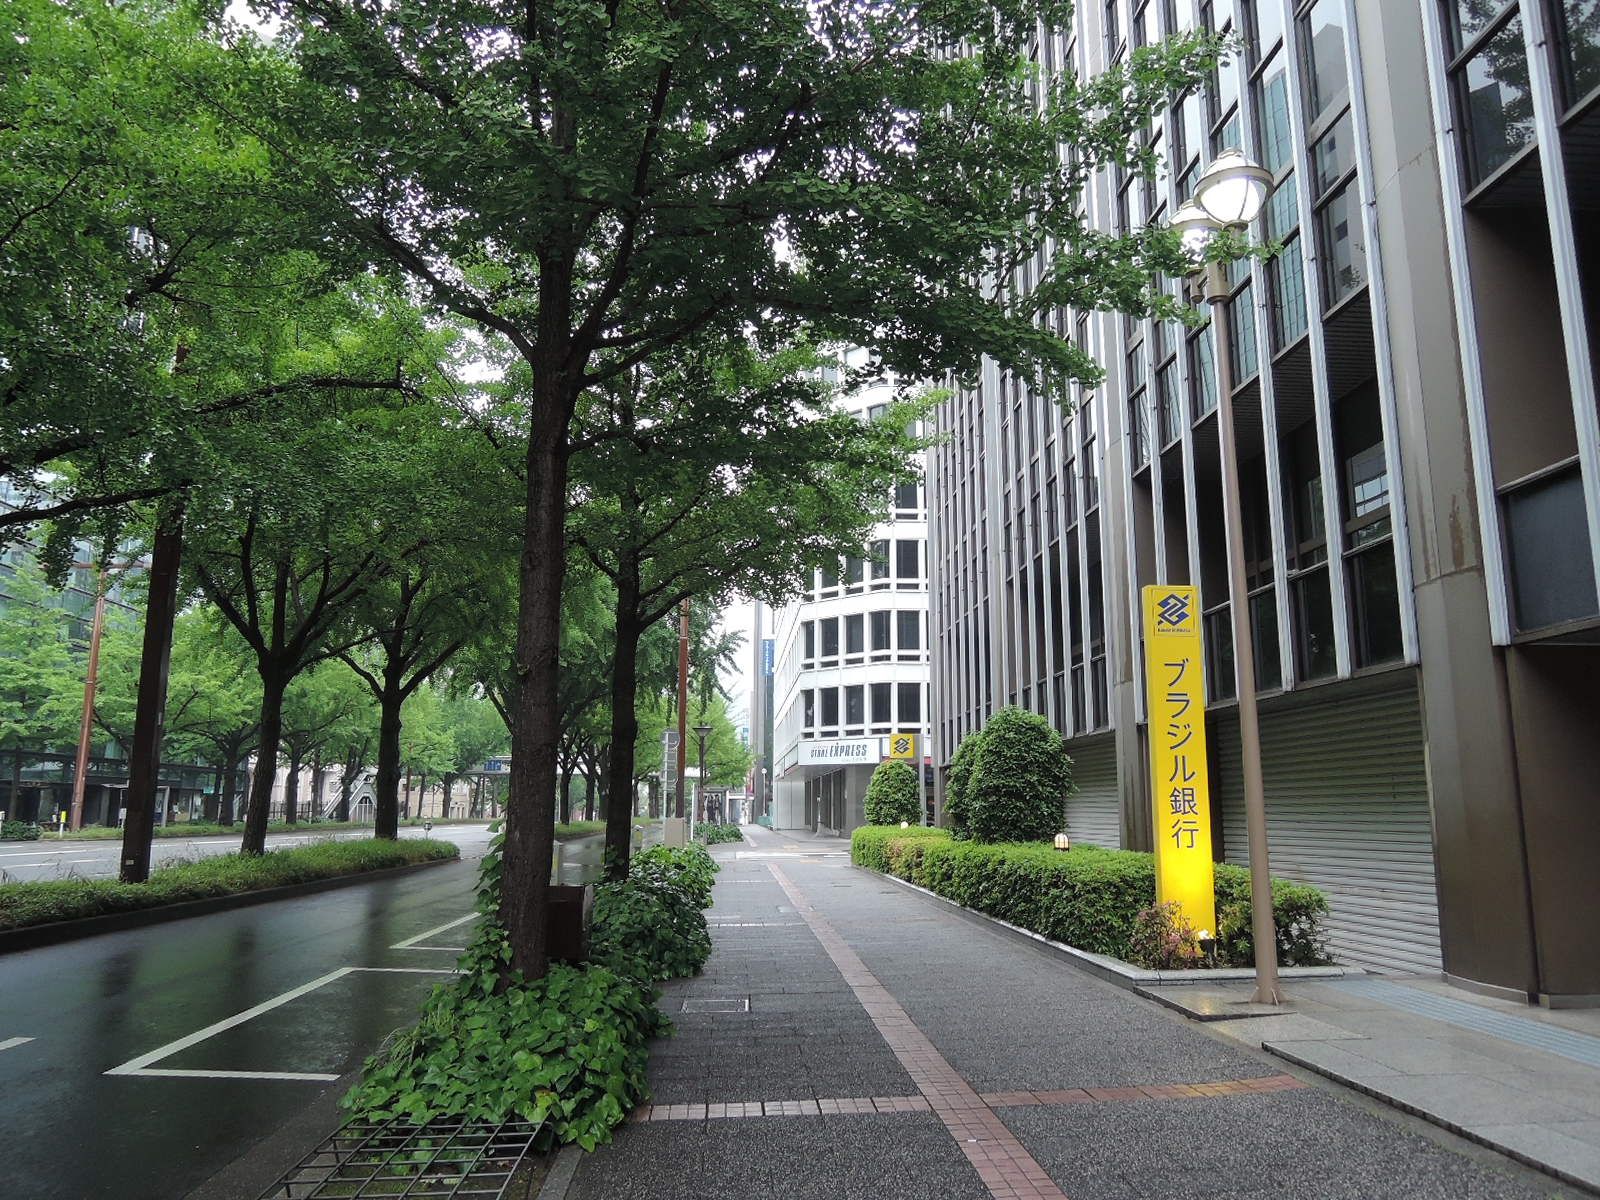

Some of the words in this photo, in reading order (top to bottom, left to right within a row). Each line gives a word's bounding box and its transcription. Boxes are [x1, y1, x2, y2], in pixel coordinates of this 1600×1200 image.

[829, 743, 867, 757] EXPRESS
[1164, 658, 1199, 848] ブラジル銀行
